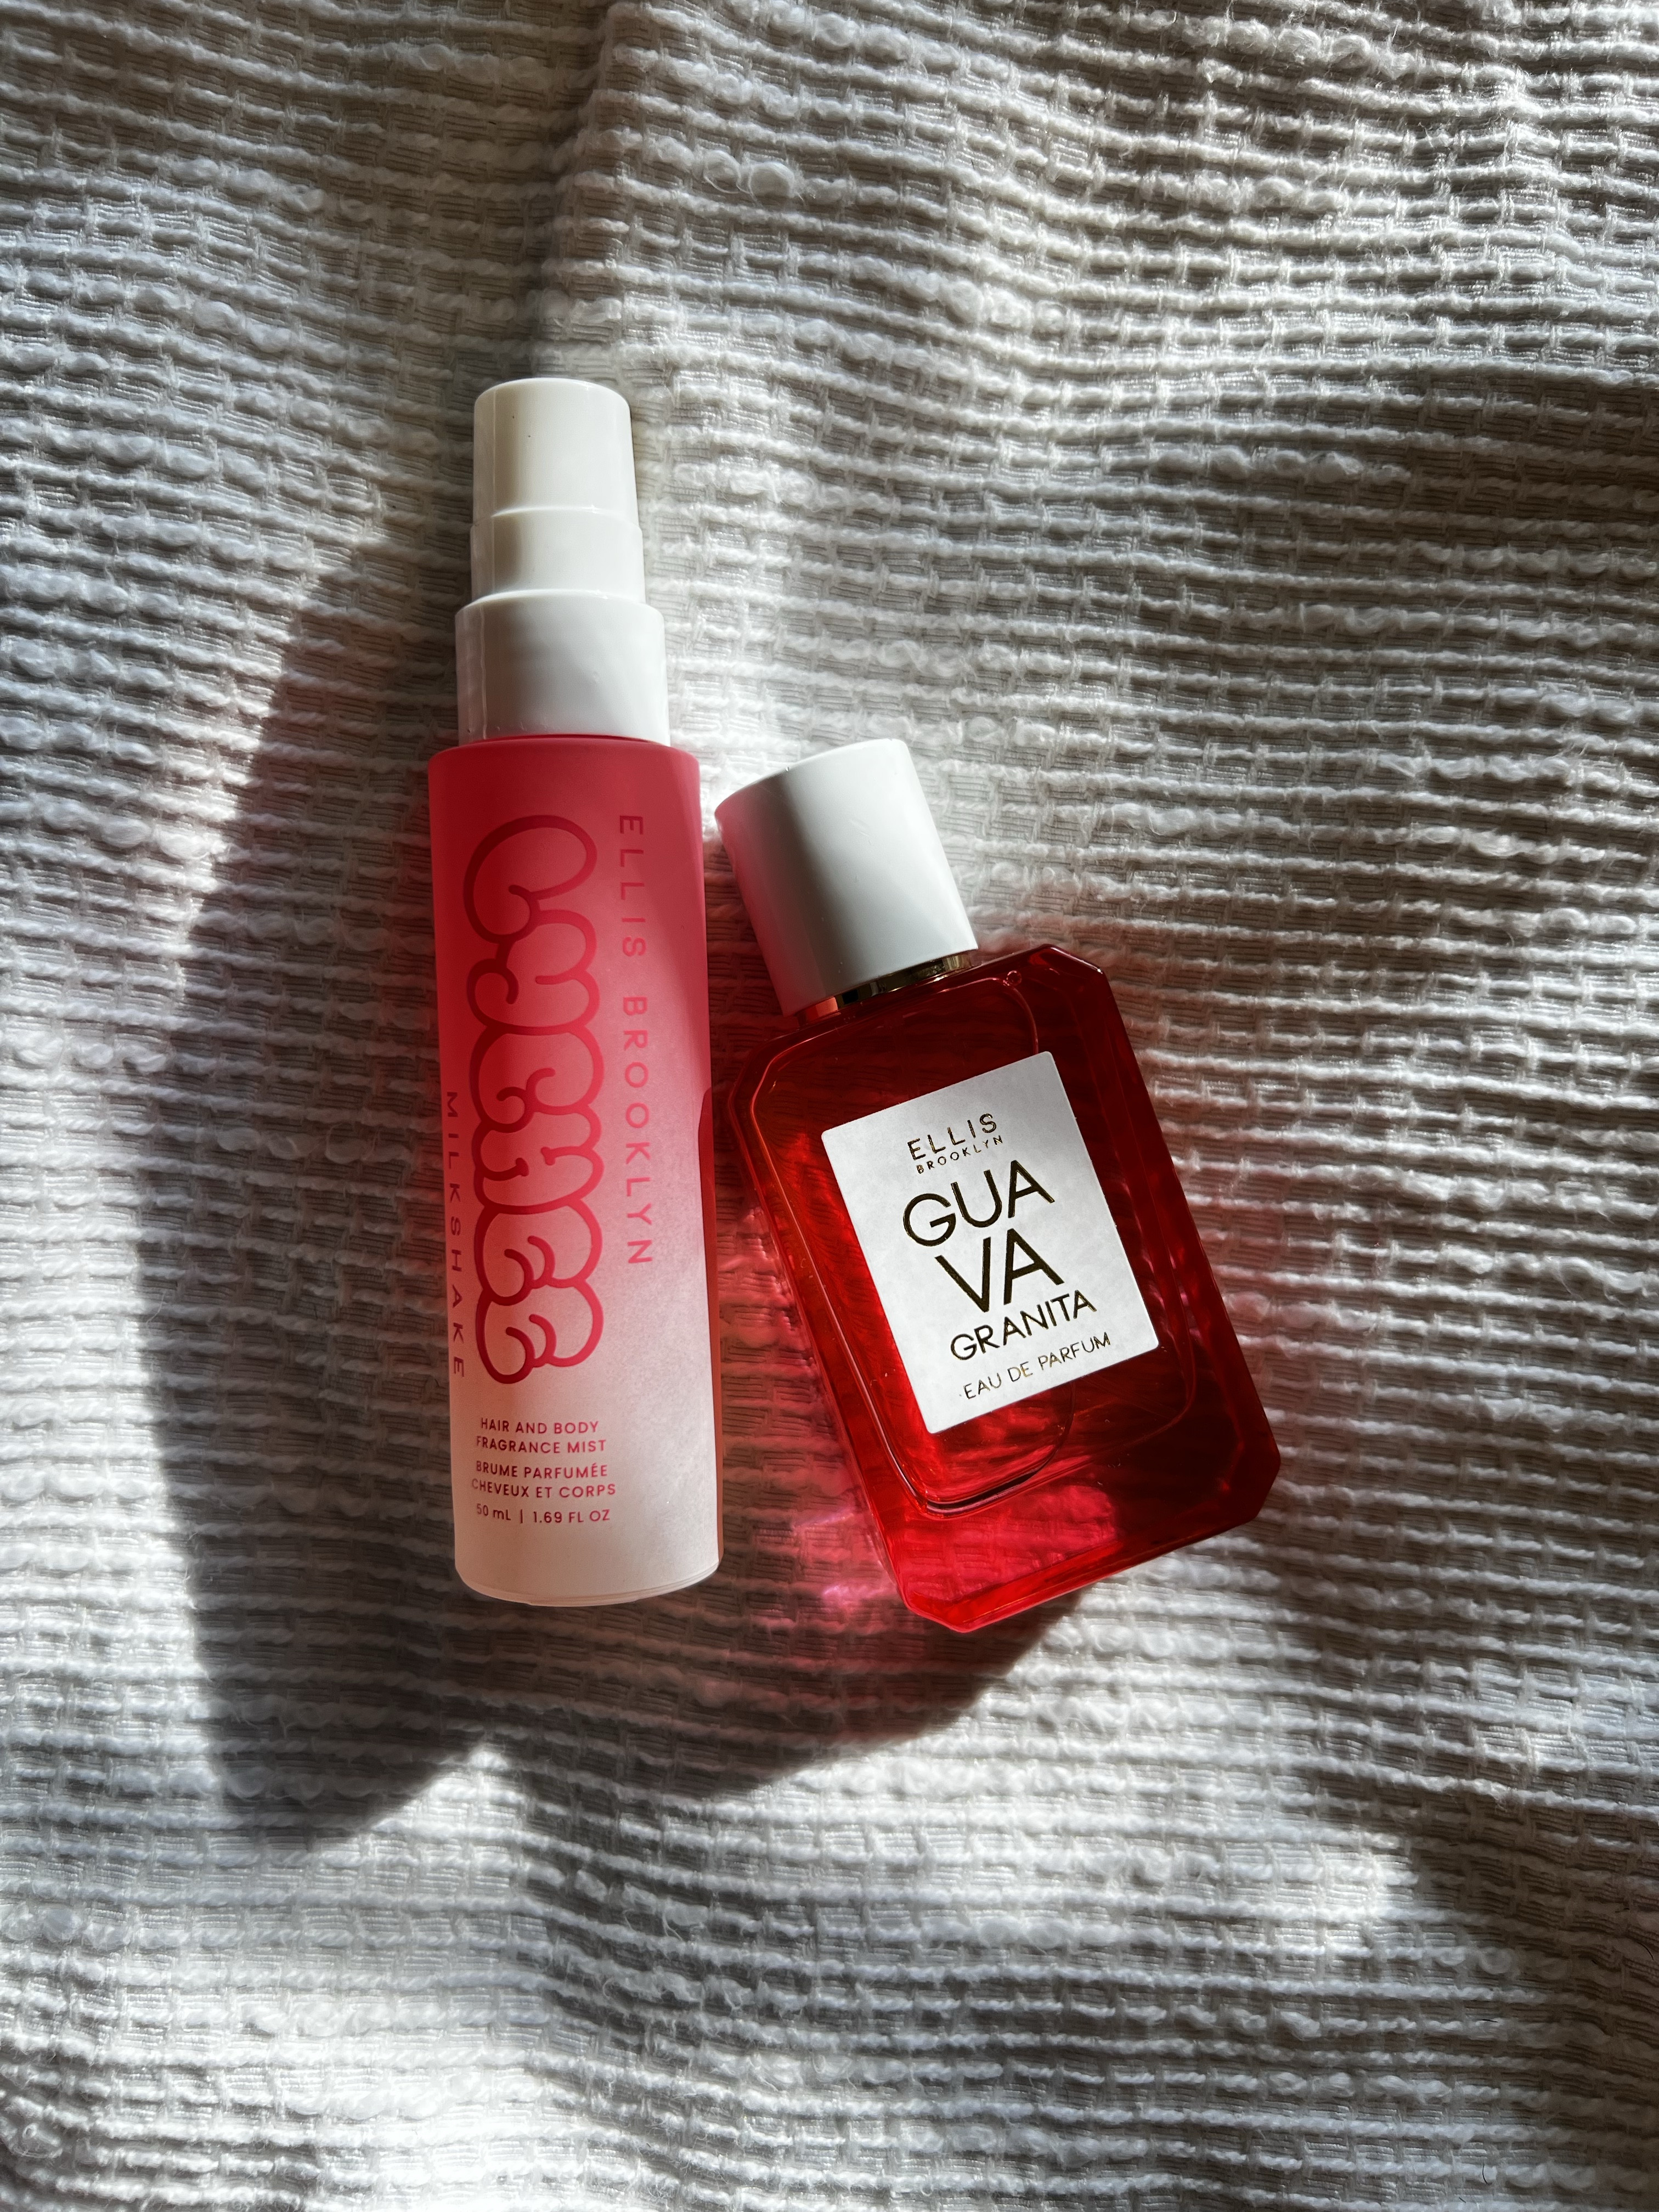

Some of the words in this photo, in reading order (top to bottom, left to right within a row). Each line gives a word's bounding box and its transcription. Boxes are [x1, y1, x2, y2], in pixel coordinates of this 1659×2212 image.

[619, 815, 646, 958] ELLIS
[463, 815, 604, 1384] LYCHEE
[623, 996, 653, 1263] BROOKLYN
[907, 1114, 997, 1160] ELLIS
[916, 1135, 1003, 1174] BROOKLYN
[447, 1092, 464, 1377] MILKSHAKE
[902, 1160, 1056, 1247] GUA
[935, 1228, 1065, 1313] VA
[950, 1290, 1097, 1361] GRANITA
[964, 1373, 1002, 1400] EAU
[1007, 1362, 1034, 1383] DE
[1038, 1332, 1111, 1372] PARFUM
[476, 1435, 560, 1453] FRAGRANCE
[567, 1440, 606, 1453] MIST
[481, 1417, 509, 1432] HAIR
[516, 1421, 548, 1434] AND
[554, 1421, 599, 1434] BODY
[472, 1478, 529, 1497] CHEVEUX
[536, 1487, 552, 1498] ET
[559, 1483, 616, 1498] CORPS
[476, 1460, 518, 1477] BRUME
[524, 1463, 608, 1479] PARFUMÉE
[476, 1503, 489, 1516] 50
[493, 1509, 511, 1521] mL
[533, 1511, 562, 1523] 1.69
[569, 1511, 584, 1523] FL
[589, 1509, 611, 1521] OZ
